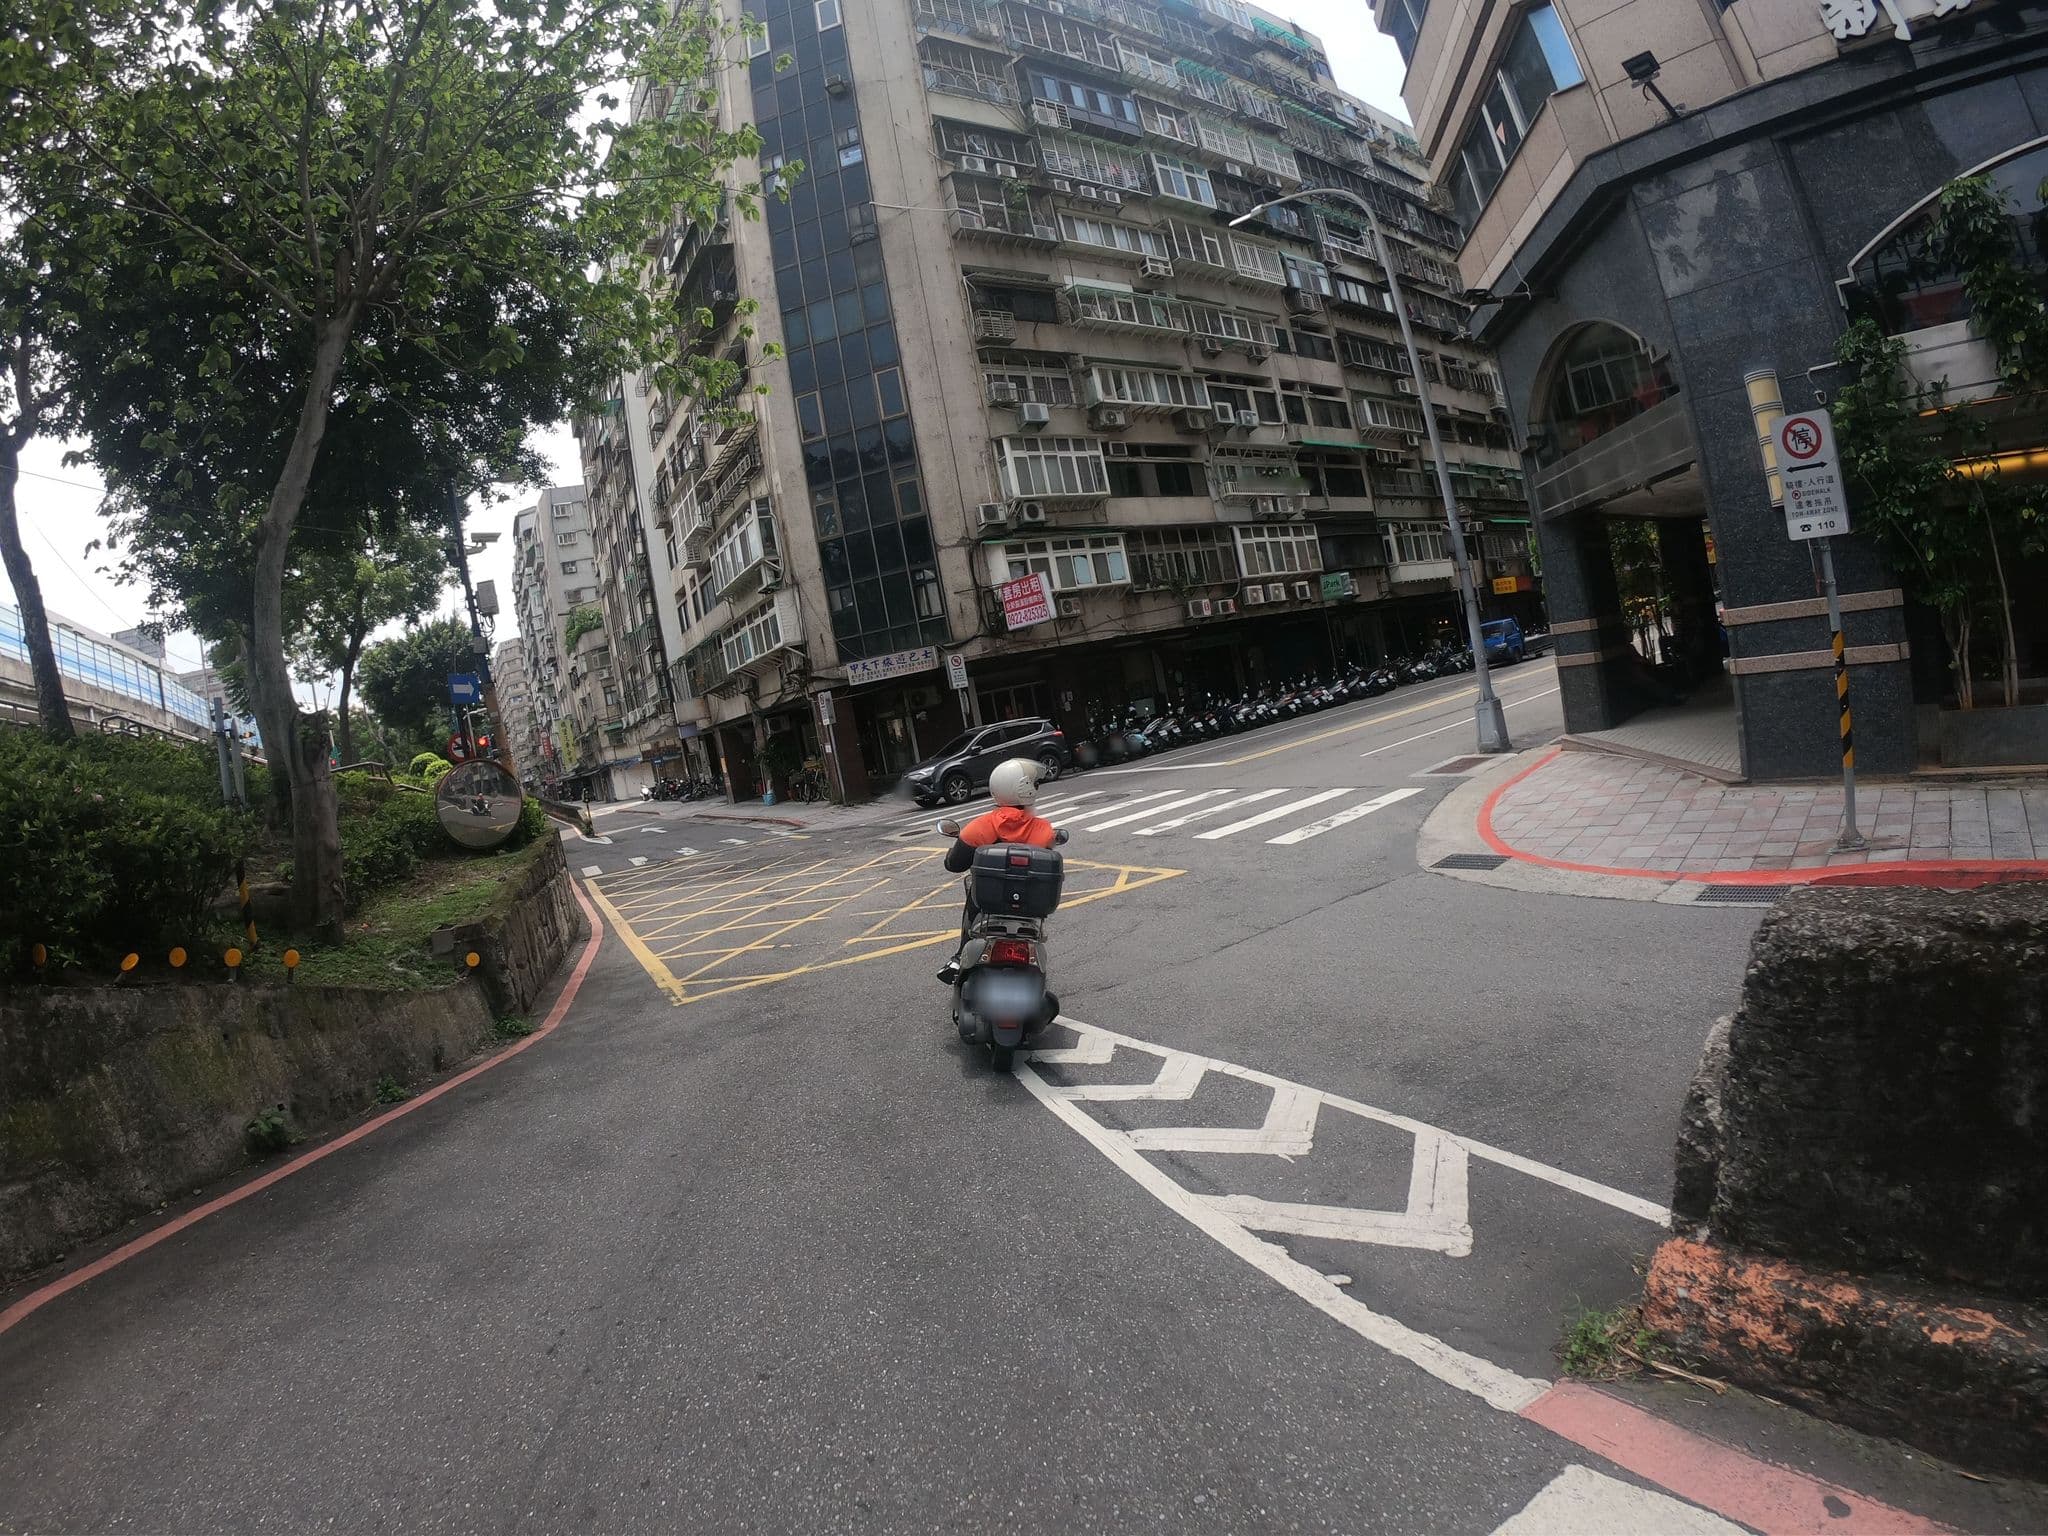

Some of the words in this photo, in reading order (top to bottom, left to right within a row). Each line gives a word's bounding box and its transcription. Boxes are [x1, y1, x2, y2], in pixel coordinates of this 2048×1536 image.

[1818, 520, 1836, 531] 110
[1002, 576, 1041, 602] 套房出租
[849, 649, 933, 674] 甲天下旅遊巴士
